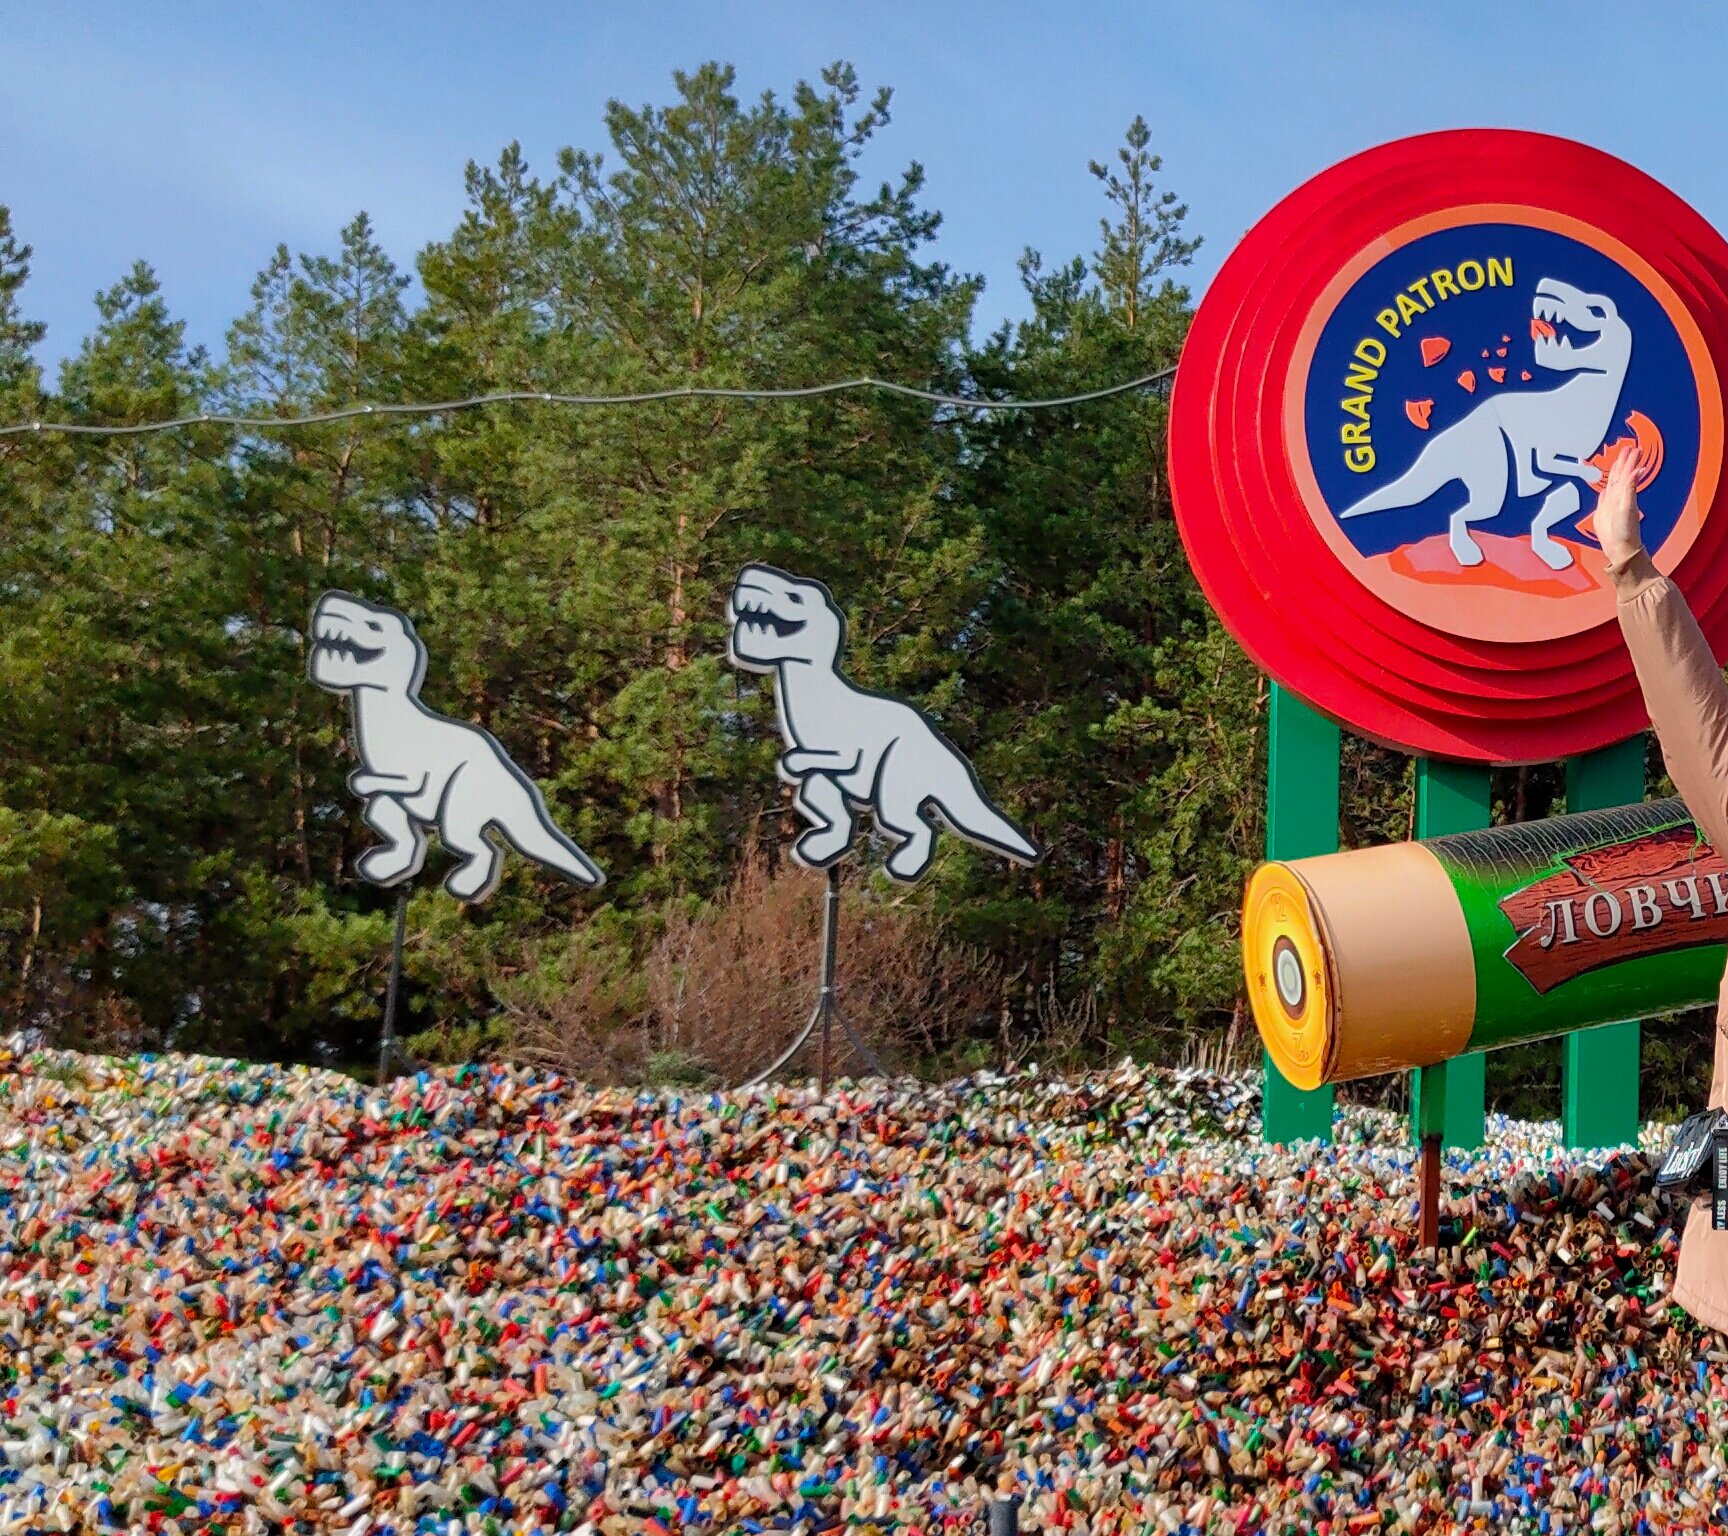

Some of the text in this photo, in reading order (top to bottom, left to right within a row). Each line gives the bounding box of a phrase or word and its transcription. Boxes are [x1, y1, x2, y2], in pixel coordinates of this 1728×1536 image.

[1341, 257, 1515, 474] GRAND PATRON
[1718, 1146, 1728, 1164] LIFE
[1717, 1164, 1728, 1190] ENJOY
